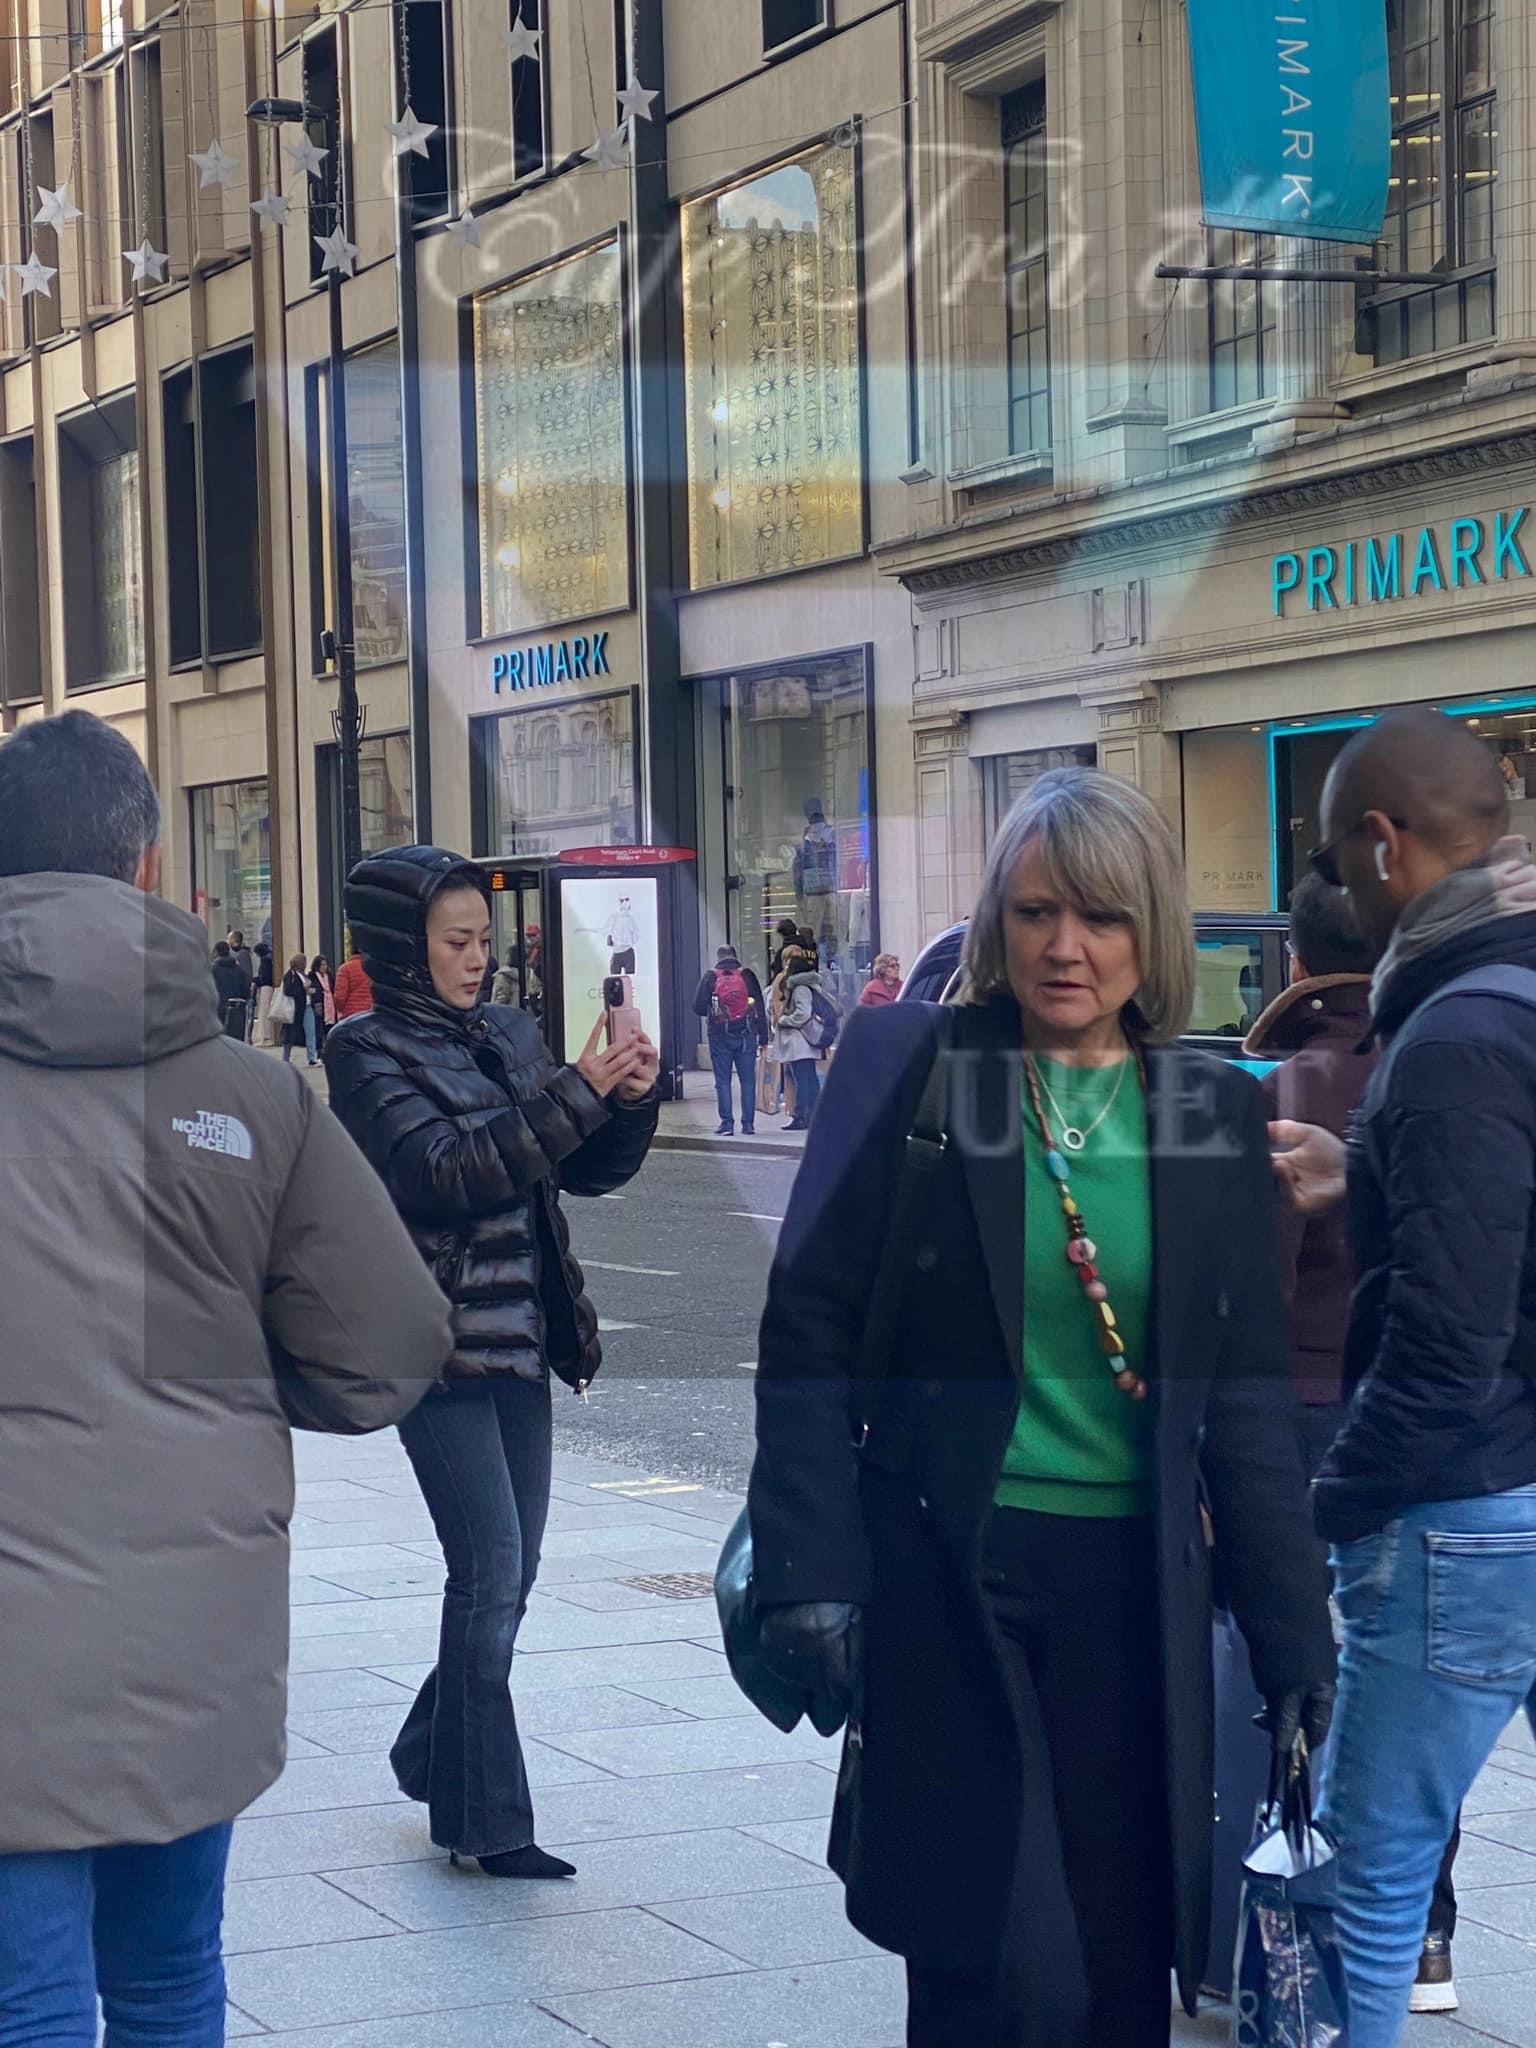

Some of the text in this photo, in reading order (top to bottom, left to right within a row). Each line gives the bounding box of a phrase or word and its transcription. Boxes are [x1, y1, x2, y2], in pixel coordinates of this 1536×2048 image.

[1275, 0, 1314, 206] IMARK
[1271, 505, 1531, 619] PRIMARK
[492, 632, 610, 694] PRIMARK
[1203, 870, 1265, 881] PRMARK
[172, 1117, 226, 1141] NORTH
[196, 1110, 227, 1128] THE
[187, 1134, 226, 1153] FACE
